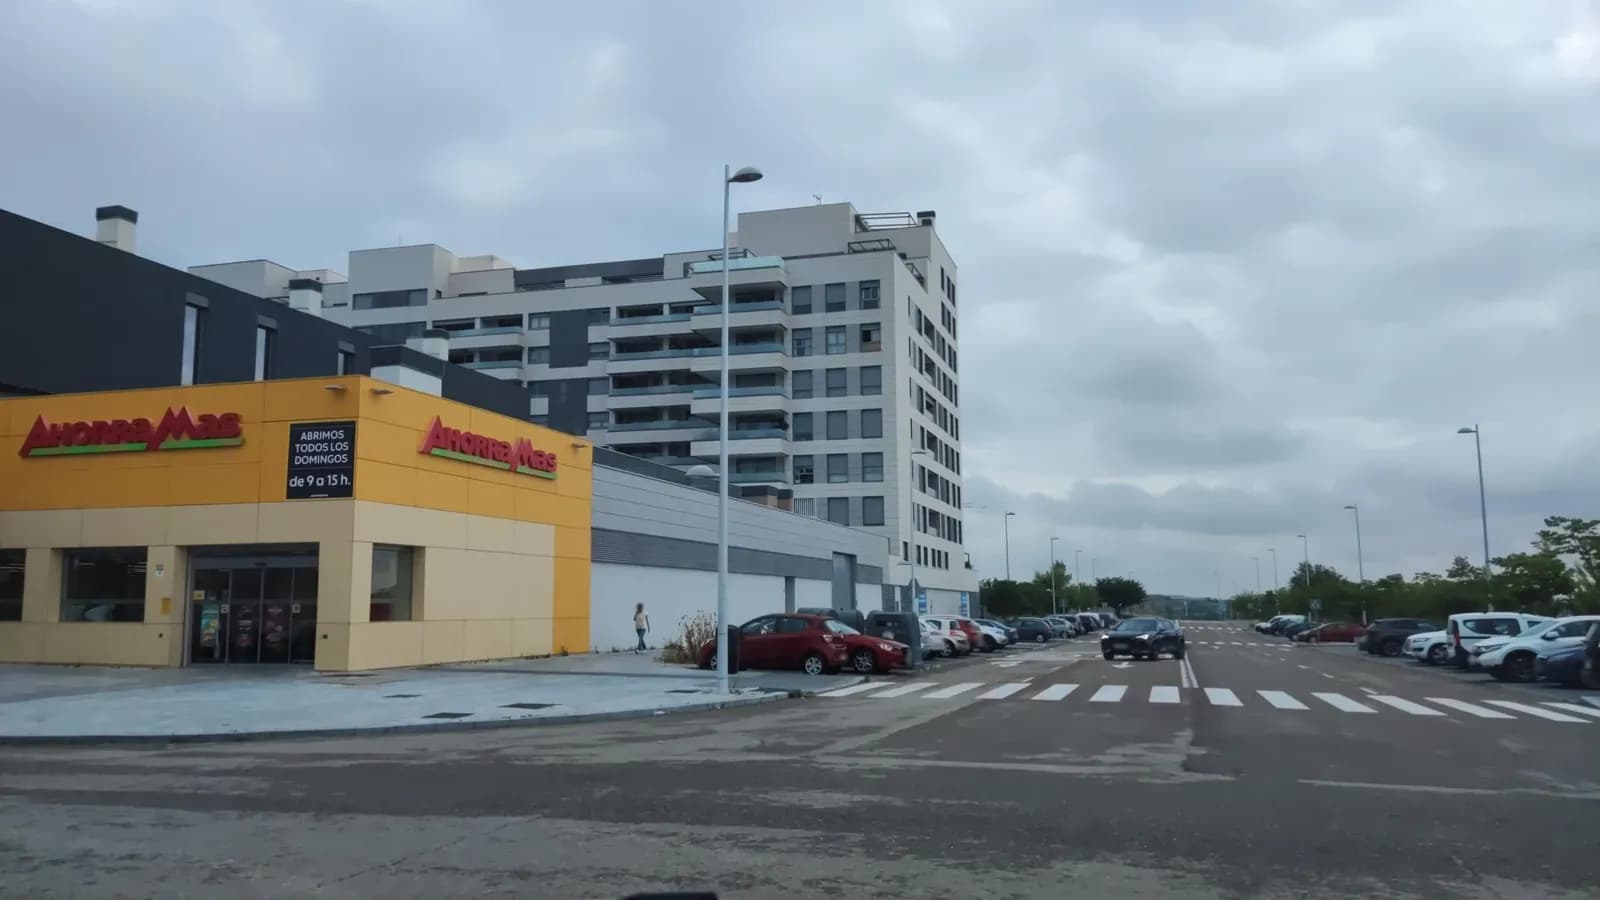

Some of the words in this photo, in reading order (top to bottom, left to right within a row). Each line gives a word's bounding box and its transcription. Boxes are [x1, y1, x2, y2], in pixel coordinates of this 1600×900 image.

[300, 430, 345, 441] ABRIMOS
[295, 443, 329, 453] TODOS
[330, 441, 349, 452] LOS
[294, 454, 349, 465] DOMINGOS
[289, 475, 305, 488] de
[306, 475, 315, 487] 9
[316, 477, 325, 487] a
[327, 474, 339, 486] 15
[340, 473, 352, 486] h.
